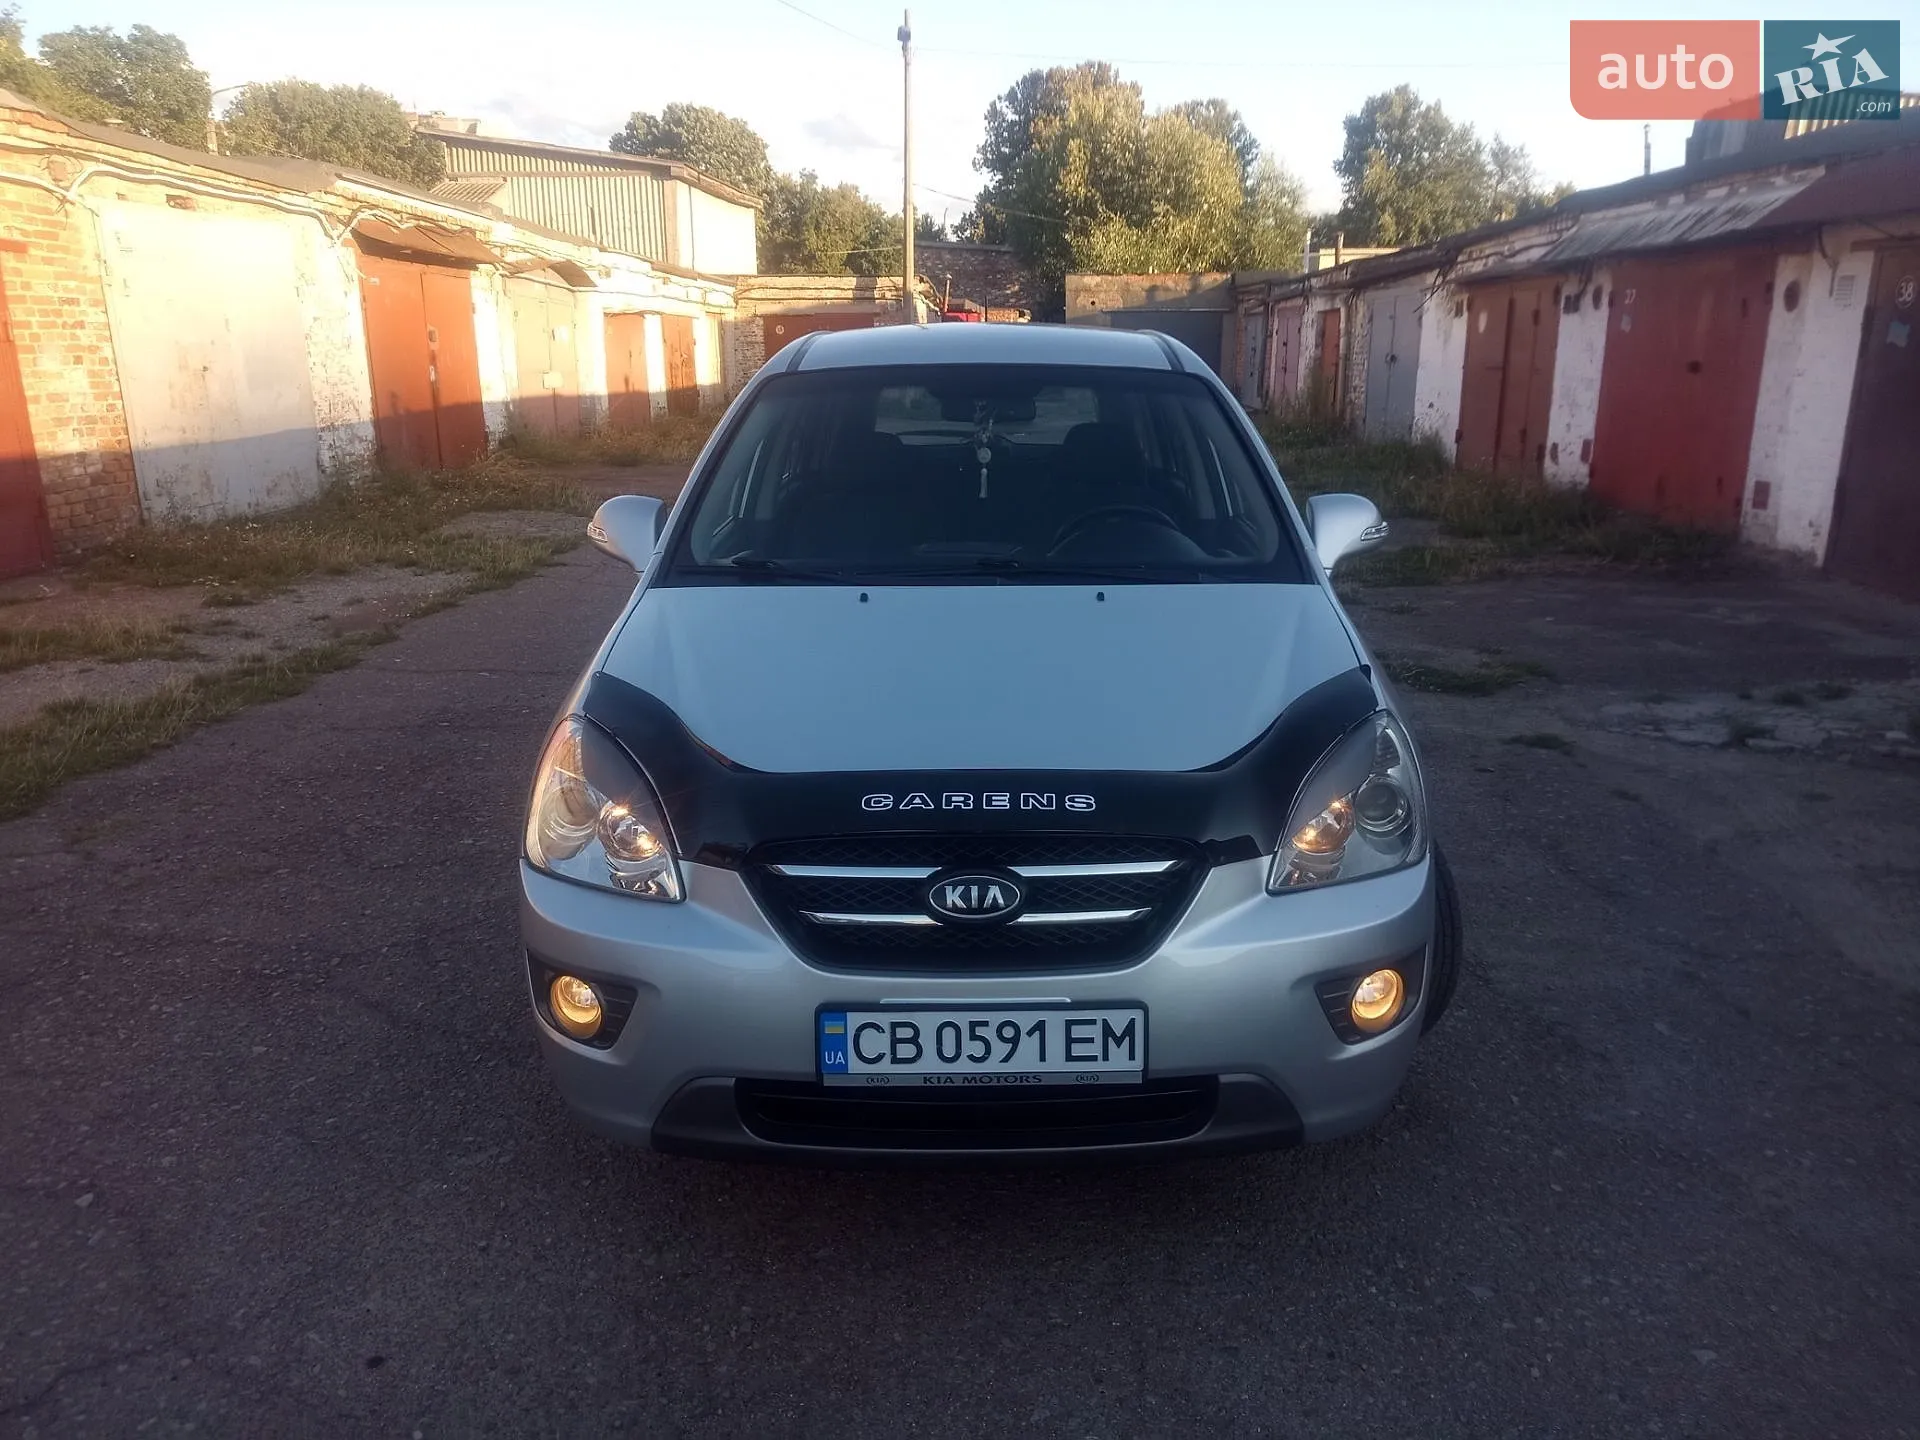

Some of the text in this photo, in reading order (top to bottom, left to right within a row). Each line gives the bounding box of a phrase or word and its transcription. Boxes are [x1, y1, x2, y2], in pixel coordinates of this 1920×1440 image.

[1899, 282, 1913, 301] 38
[861, 792, 1097, 812] CARENS
[944, 885, 1006, 909] KIA
[852, 1018, 1136, 1065] CB 0591 EM
[825, 1051, 846, 1065] UA
[922, 1075, 1043, 1085] KIA MOTORS
